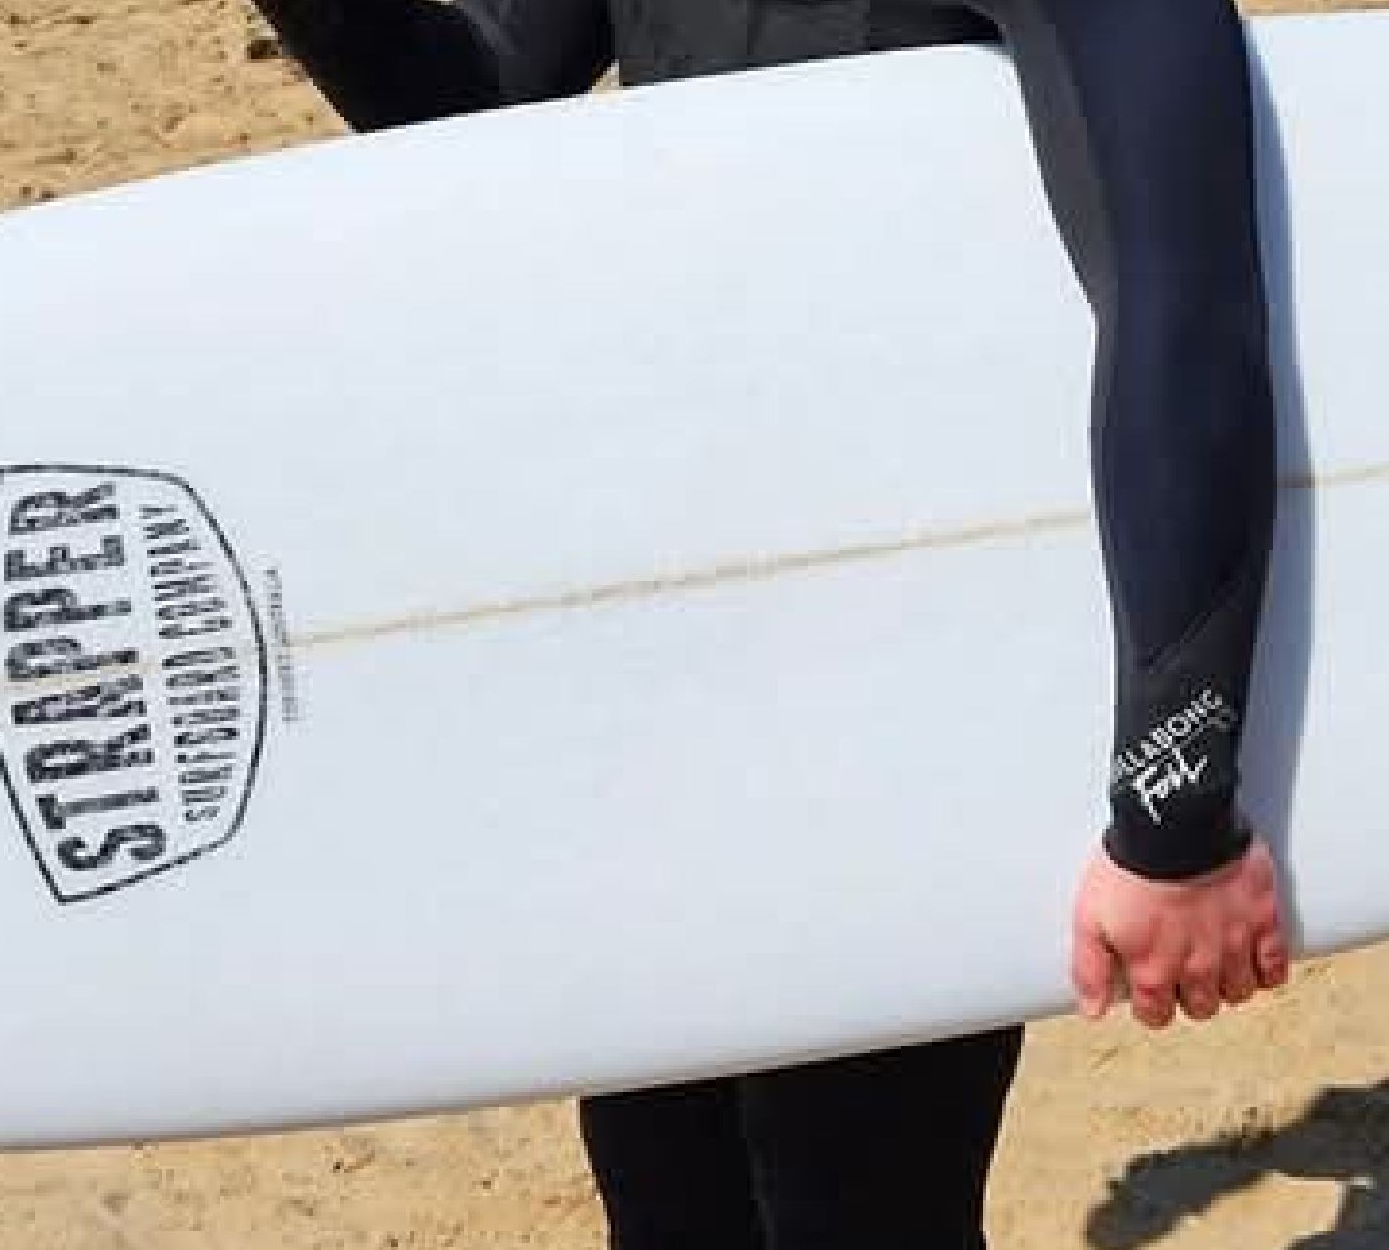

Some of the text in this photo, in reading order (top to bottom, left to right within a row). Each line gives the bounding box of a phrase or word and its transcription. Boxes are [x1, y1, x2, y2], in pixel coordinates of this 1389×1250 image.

[3, 482, 167, 869] STRAPPER
[139, 503, 242, 822] SURFBOARD COMPANY
